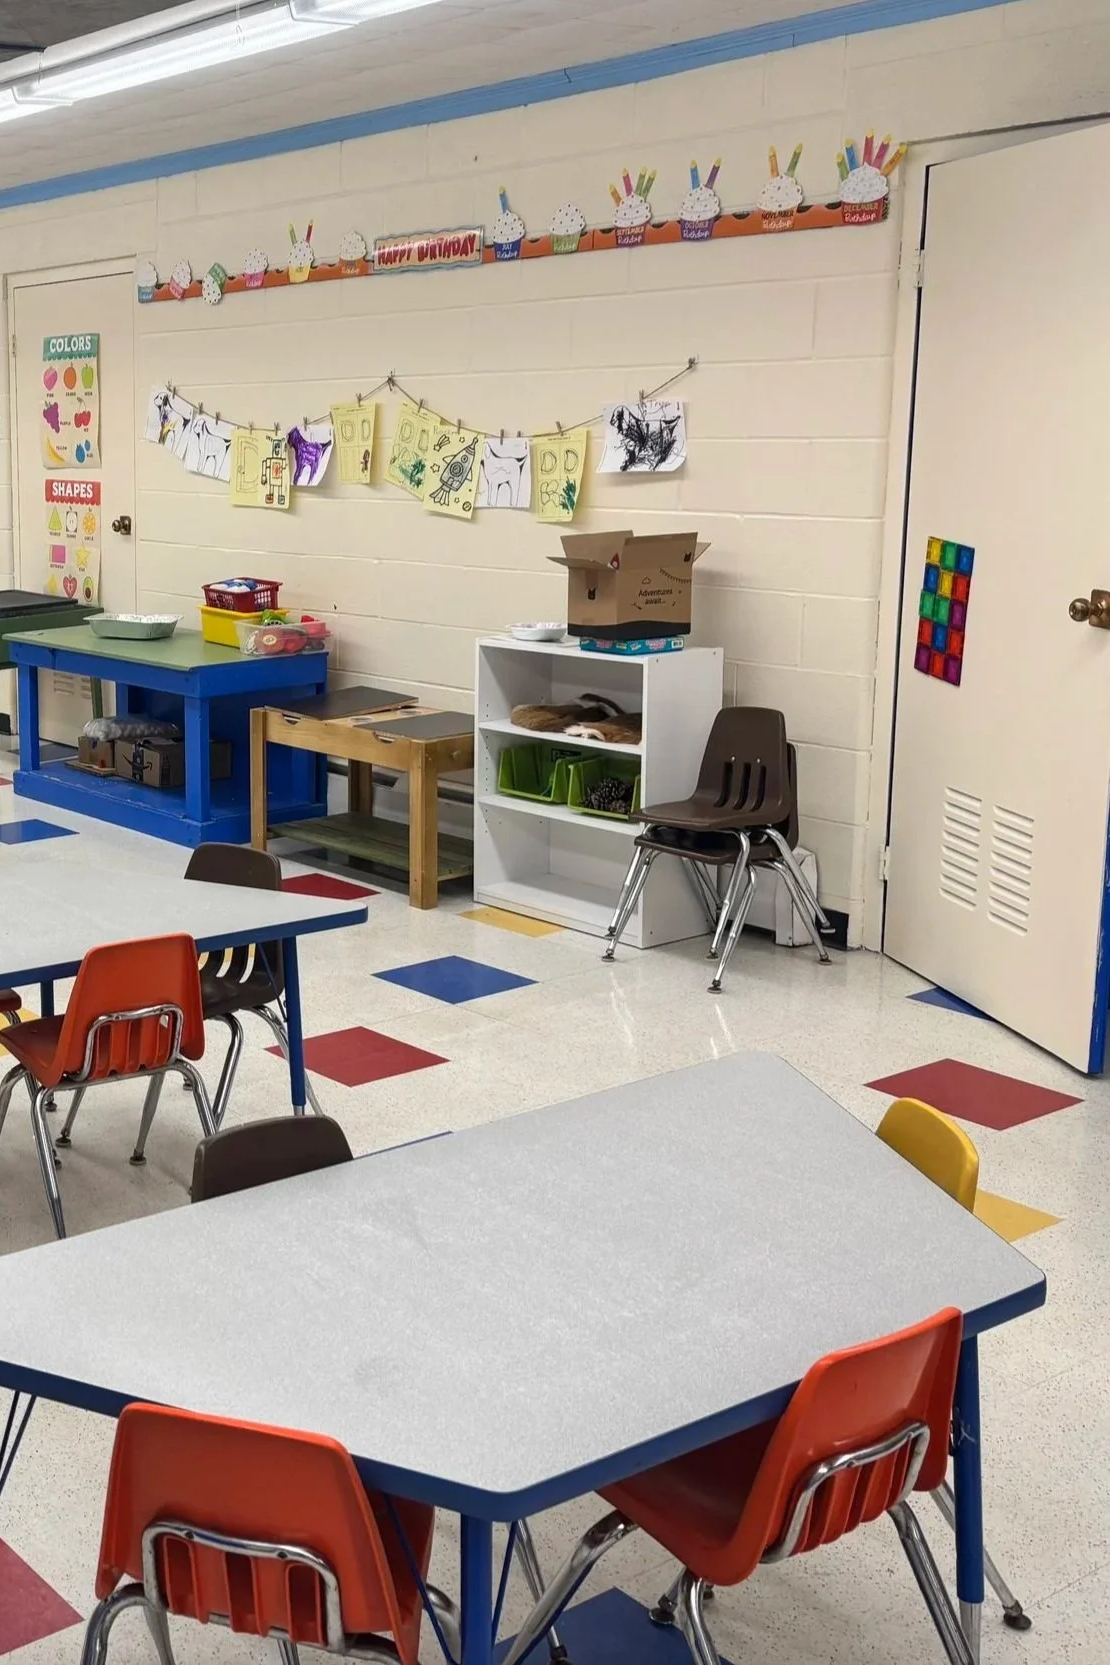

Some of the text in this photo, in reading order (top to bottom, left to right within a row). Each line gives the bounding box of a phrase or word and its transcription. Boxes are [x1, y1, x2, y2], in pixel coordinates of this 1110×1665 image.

[843, 203, 878, 212] DECEMBER
[761, 210, 794, 220] NOVEMBER
[684, 221, 709, 230] OCTOBER
[616, 227, 645, 236] SEPTEMBER
[377, 233, 477, 266] HAPPY BIRTHDAY
[50, 335, 92, 354] COLORS
[52, 481, 94, 499] SHAPES
[638, 588, 673, 597] Adventures
